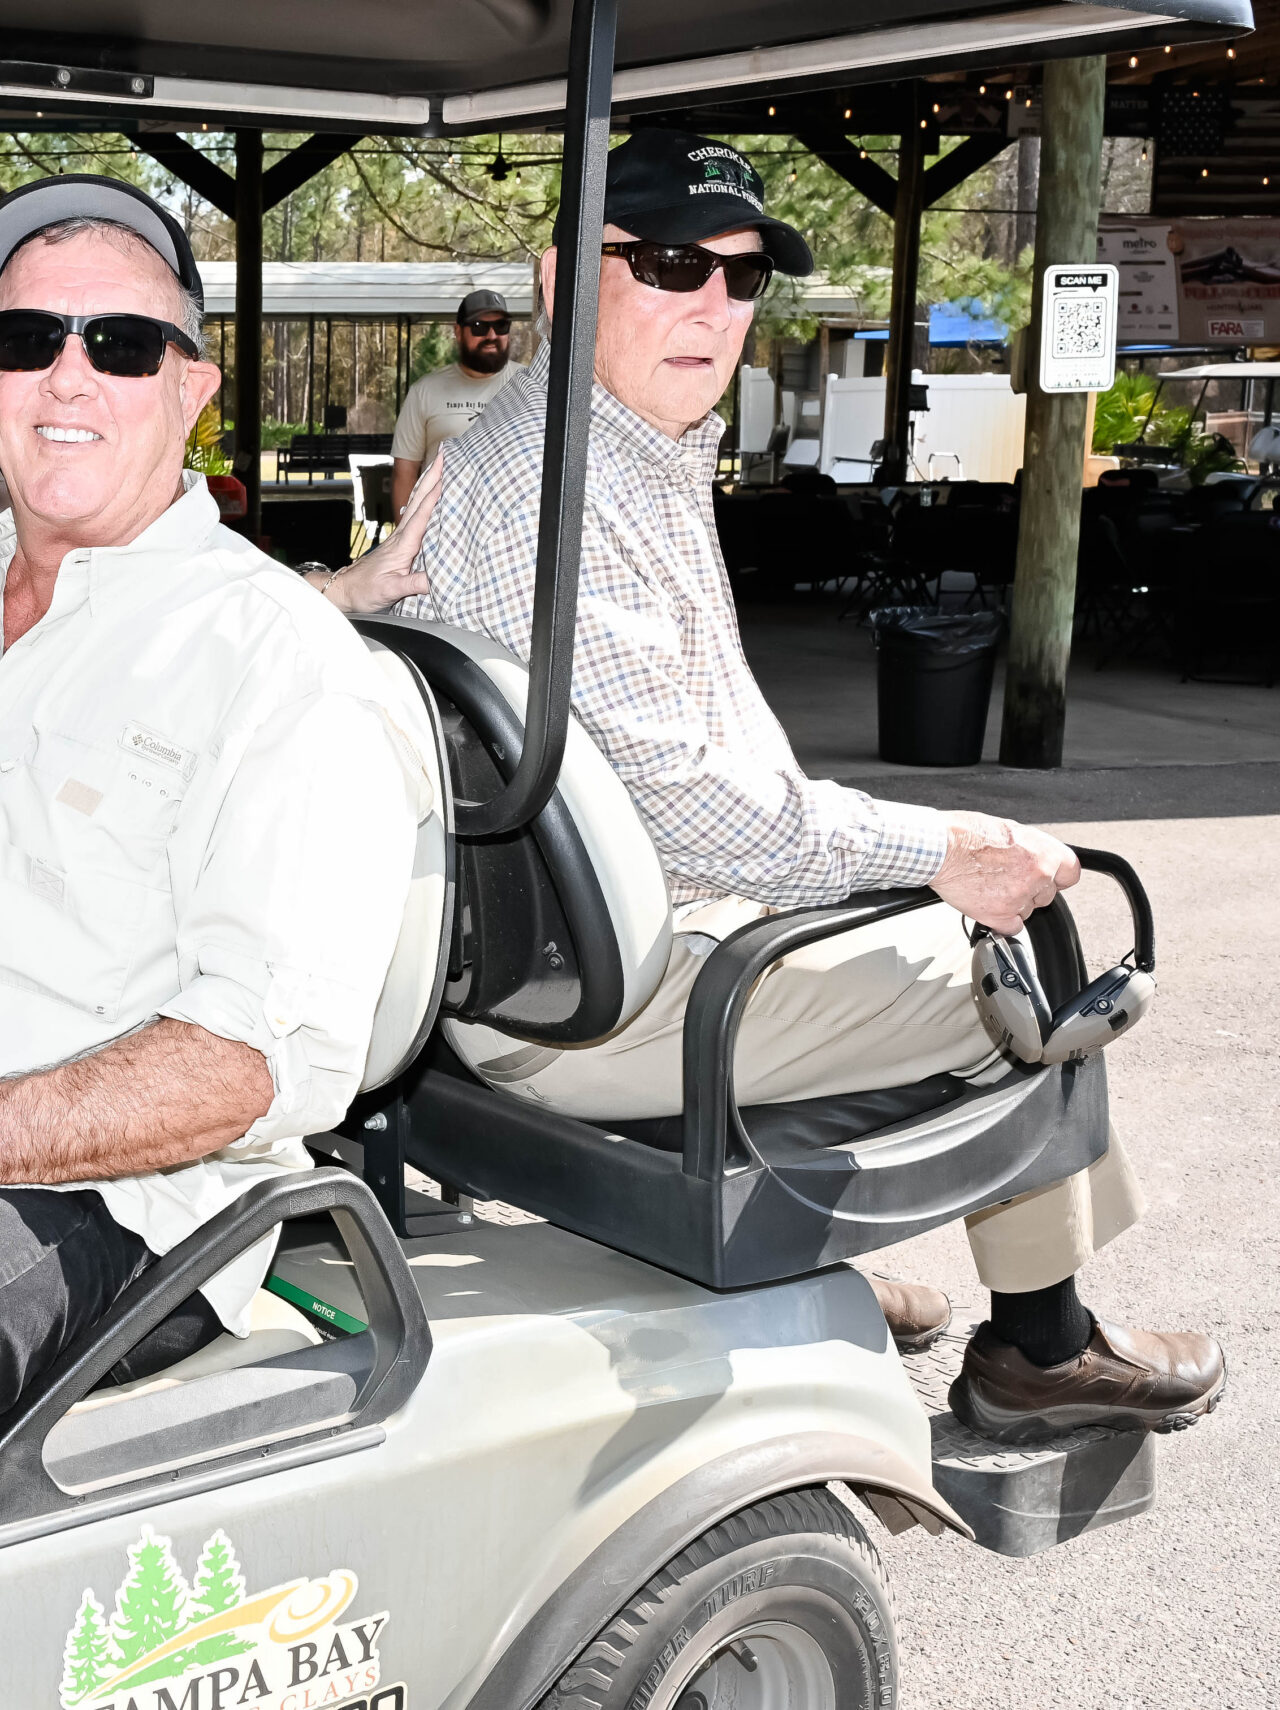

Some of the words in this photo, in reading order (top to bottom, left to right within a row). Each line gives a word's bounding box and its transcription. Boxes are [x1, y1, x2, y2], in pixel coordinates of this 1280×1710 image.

[687, 146, 752, 174] CHEROKEE
[688, 183, 742, 197] NATIONAL
[1122, 237, 1157, 249] metro
[1060, 276, 1086, 286] SCAN
[1087, 275, 1103, 286] ME
[1210, 321, 1244, 337] FARA
[143, 736, 182, 761] Columbia
[312, 1301, 336, 1320] NOTICE
[704, 1562, 776, 1621] TURF
[93, 1658, 274, 1710] MPA
[287, 1617, 386, 1689] BAY
[628, 1625, 692, 1710] UPER
[280, 1666, 377, 1710] CLAYS
